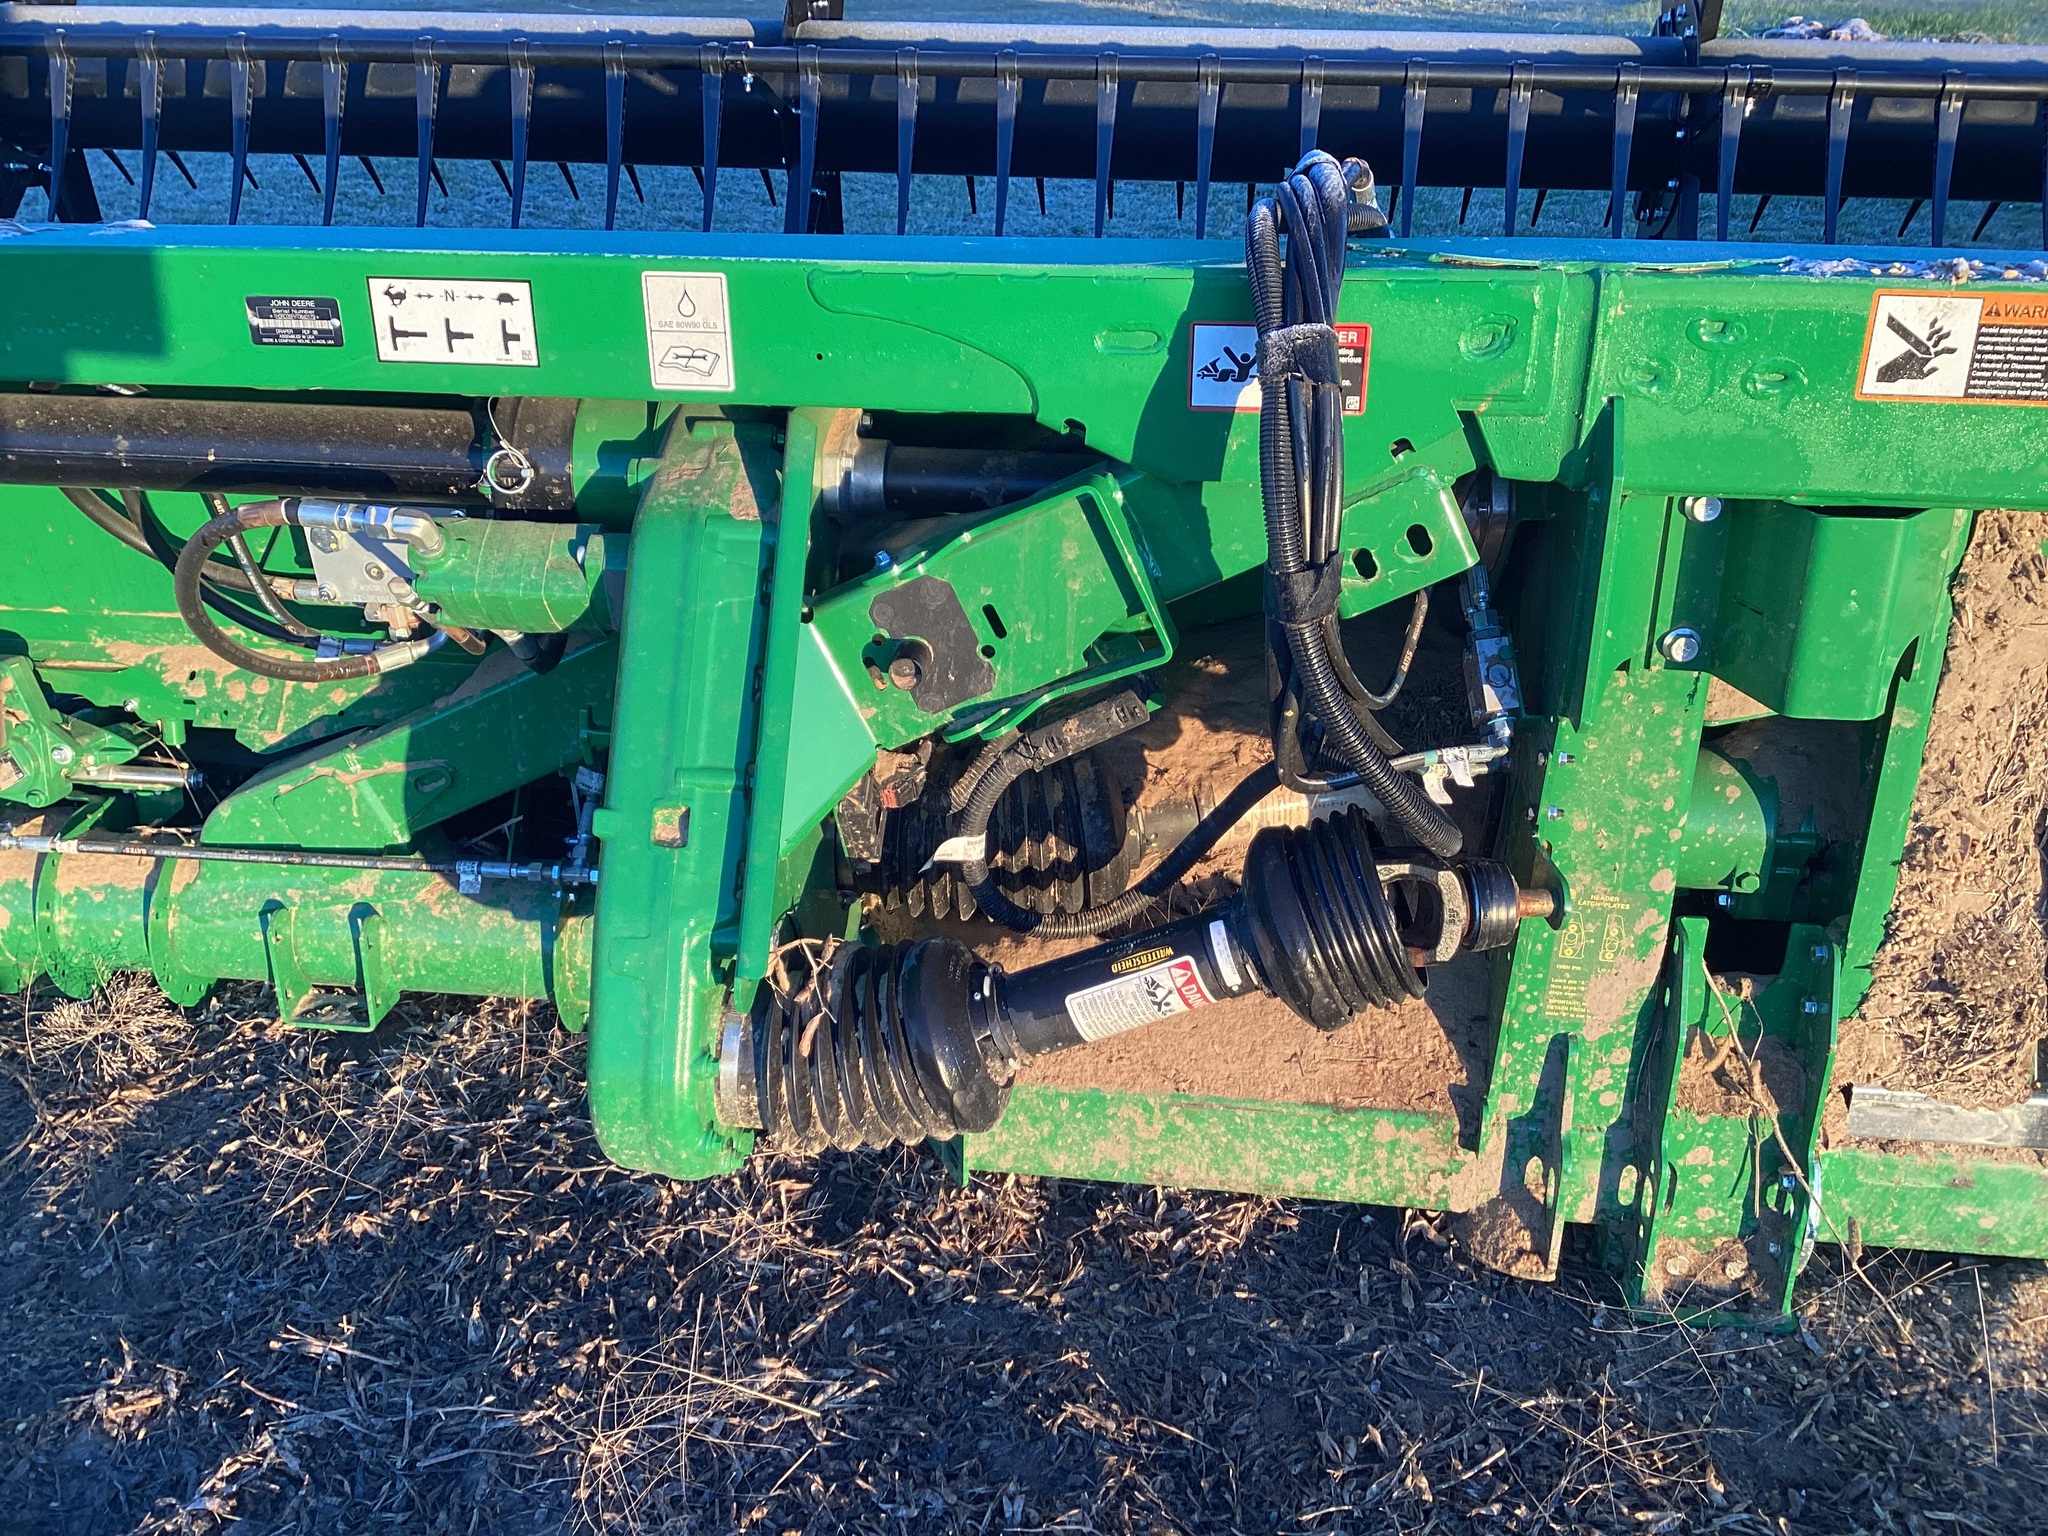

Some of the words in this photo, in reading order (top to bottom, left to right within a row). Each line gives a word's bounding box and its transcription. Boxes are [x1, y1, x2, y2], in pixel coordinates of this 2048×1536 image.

[270, 299, 290, 307] JOHN
[291, 299, 315, 307] DEERE
[658, 320, 674, 328] SAE
[676, 321, 700, 329] 80W90
[702, 321, 718, 329] GL5
[1980, 326, 1999, 334] Avoid
[1406, 650, 1418, 672] GATES
[1603, 902, 1630, 910] PLATES
[1111, 946, 1174, 973] WALTERSCHEID
